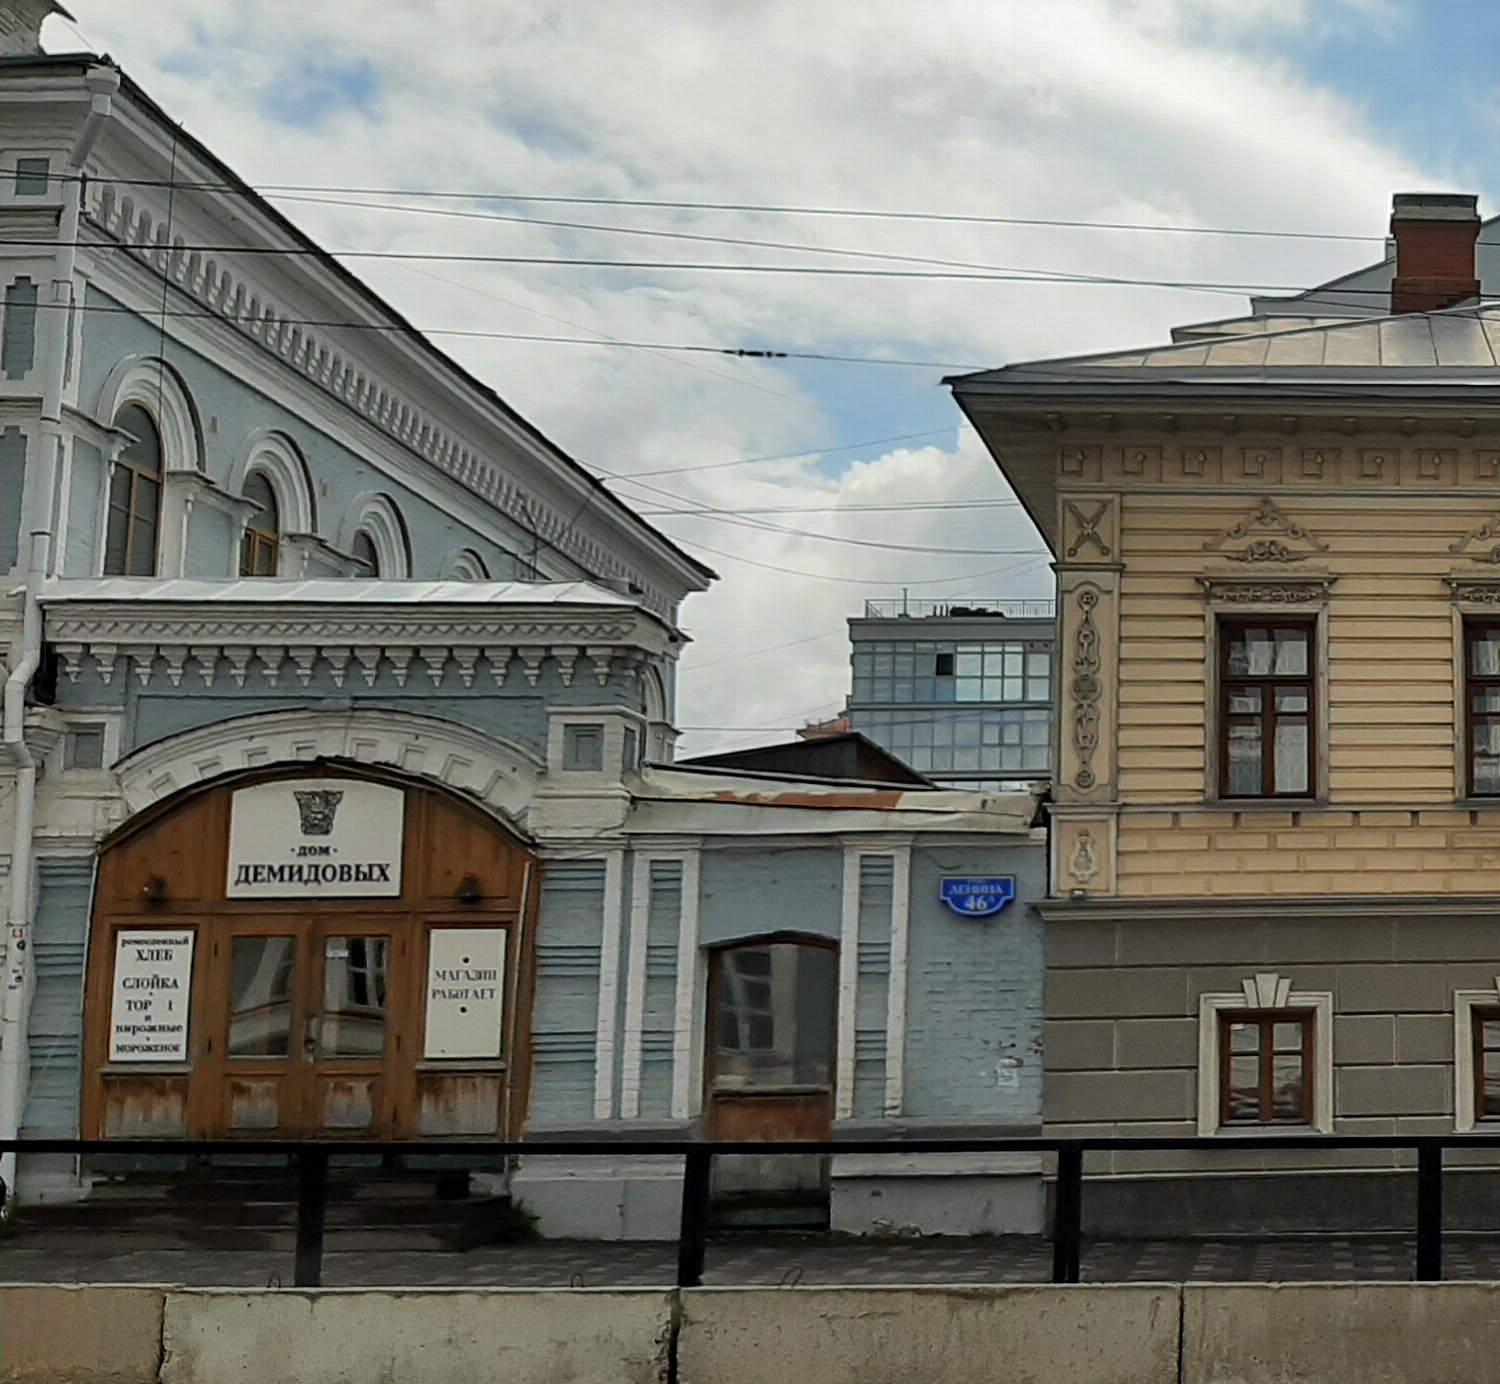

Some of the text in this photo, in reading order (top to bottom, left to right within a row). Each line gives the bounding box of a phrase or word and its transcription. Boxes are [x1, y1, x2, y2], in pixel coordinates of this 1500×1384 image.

[235, 864, 390, 886] ДЕМИДОВЫХ
[136, 949, 173, 961] ХЛЕБ
[122, 974, 179, 989] СЛОЙКА
[432, 988, 496, 999] РАБОТАЕТ
[116, 1025, 183, 1035] пирожные
